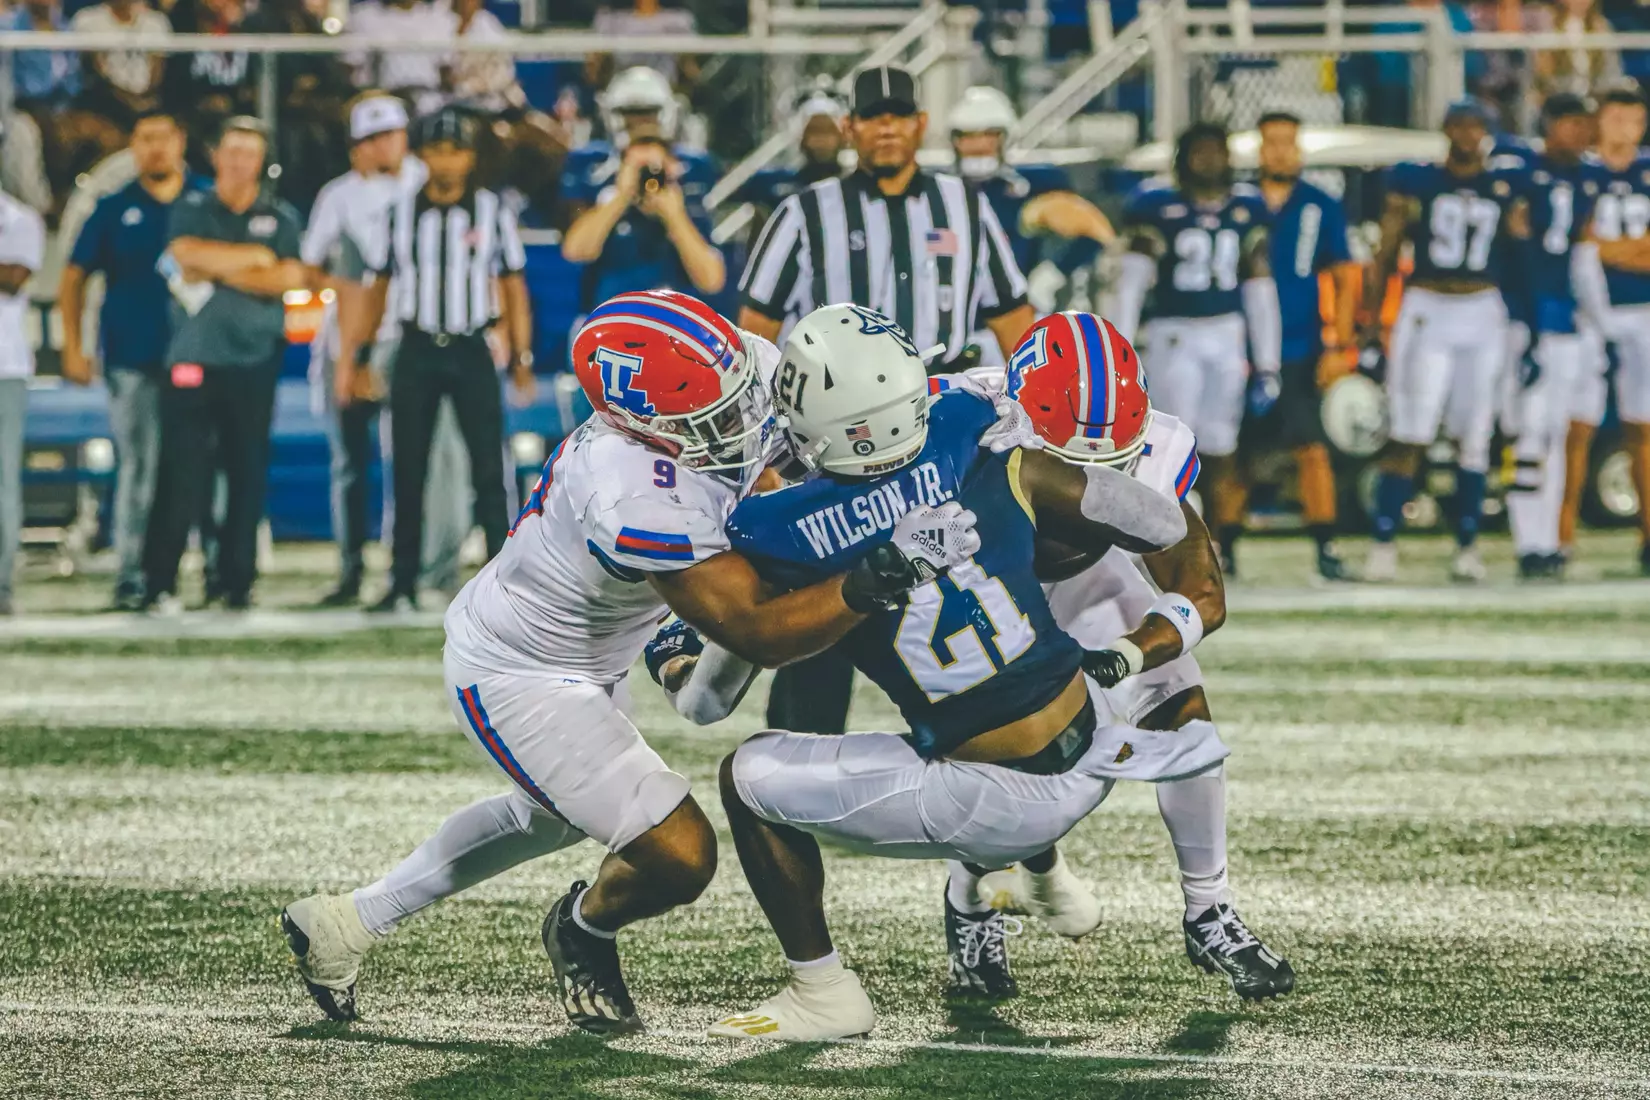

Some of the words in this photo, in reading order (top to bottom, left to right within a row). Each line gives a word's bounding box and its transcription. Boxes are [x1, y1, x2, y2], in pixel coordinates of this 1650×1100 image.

[1429, 194, 1500, 271] 97
[780, 359, 808, 417] 21
[653, 459, 677, 488] 9
[863, 457, 904, 473] PAWS
[796, 480, 907, 559] WILSON
[909, 461, 953, 510] JR.
[911, 532, 947, 559] adidas
[893, 556, 1036, 704] 21
